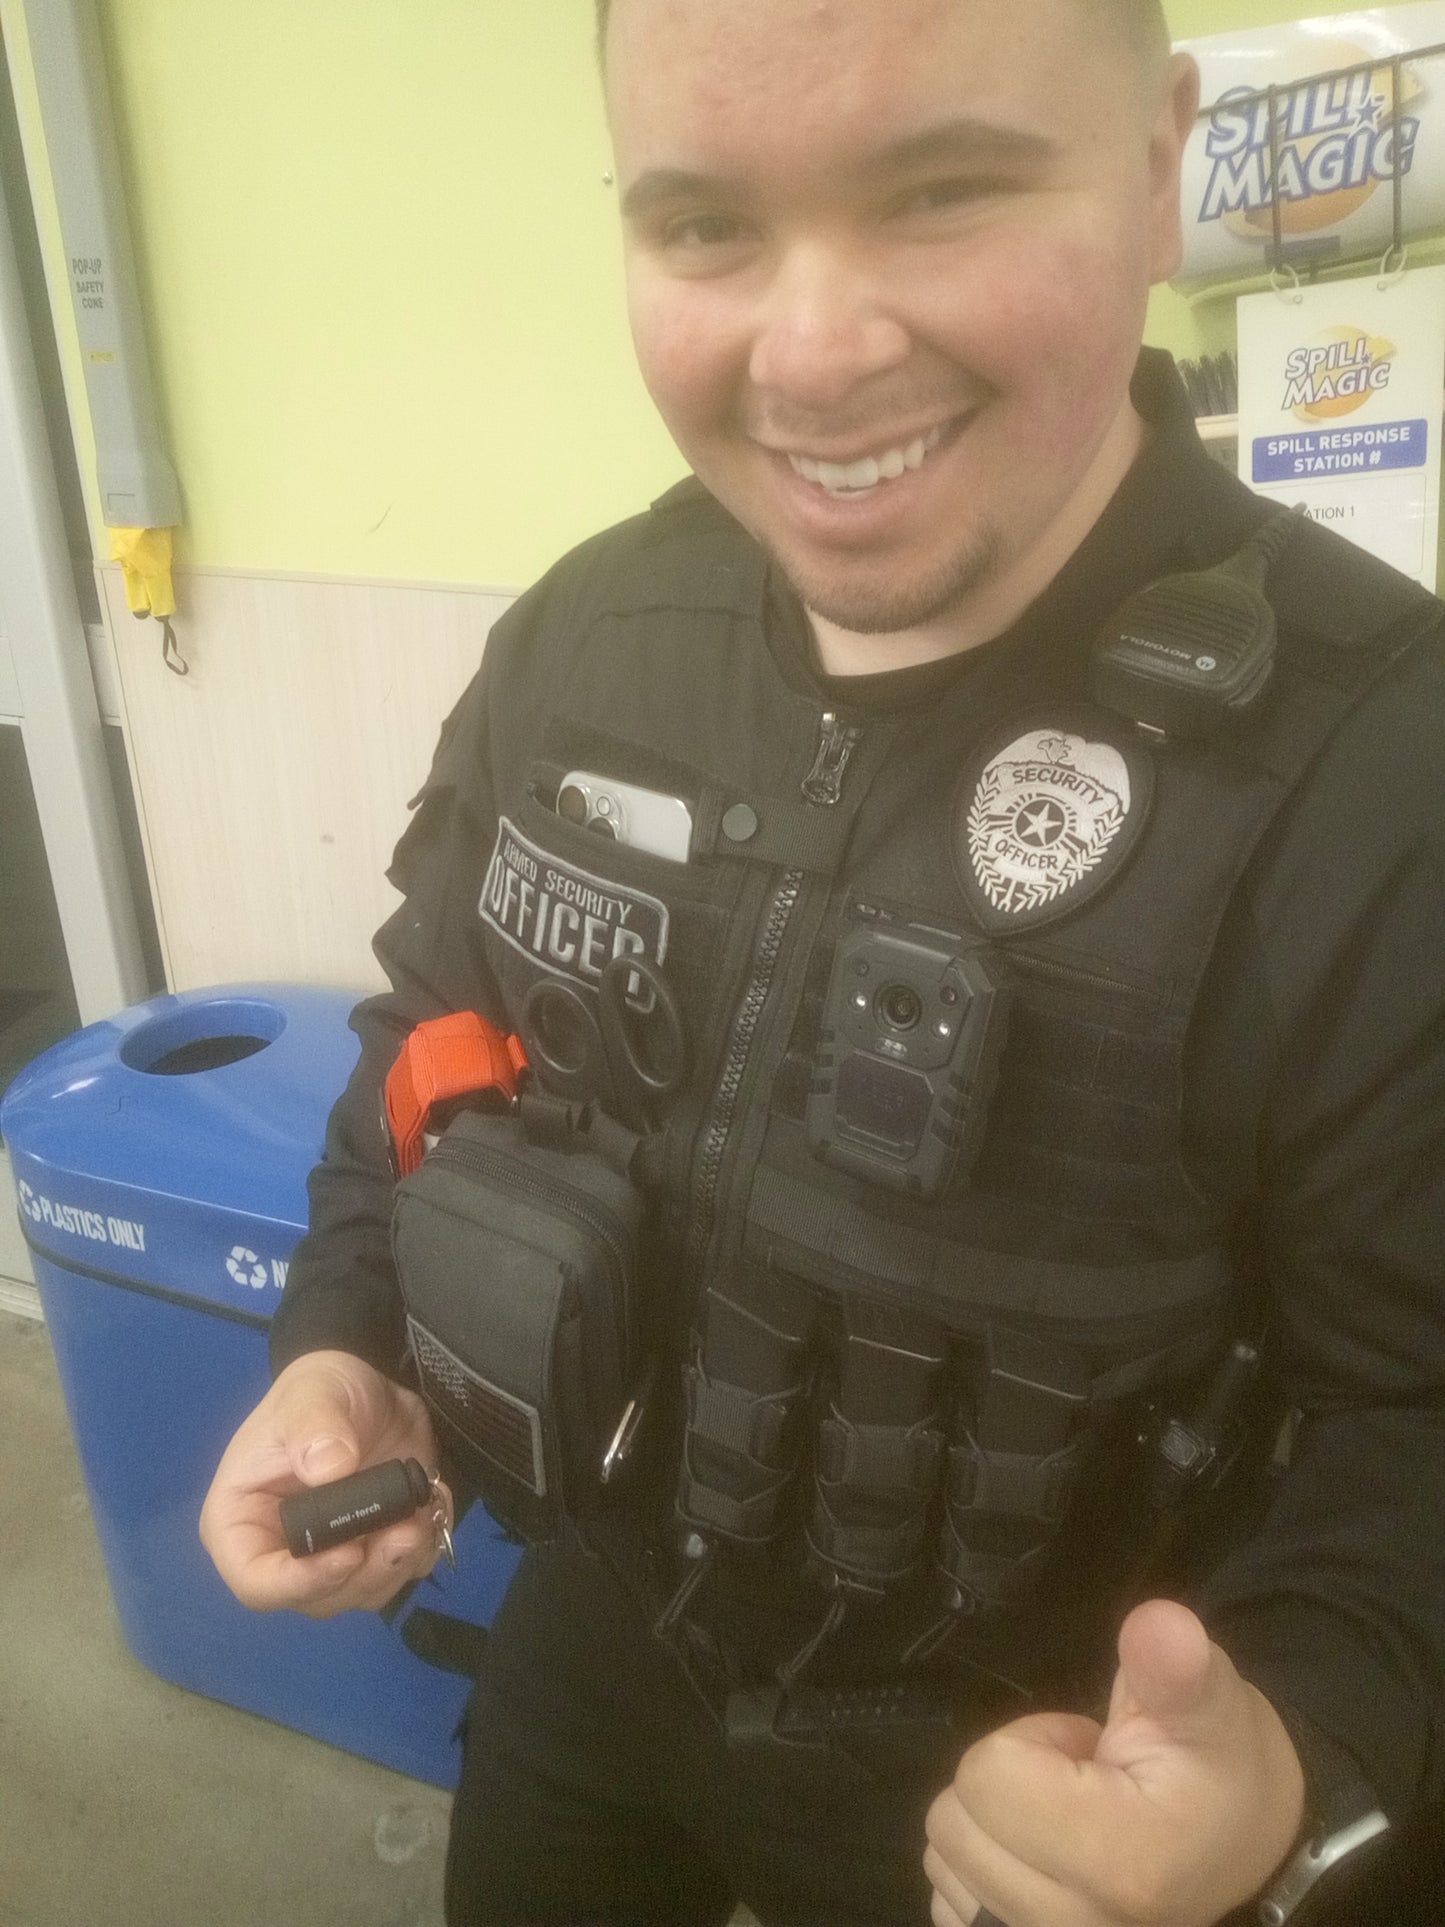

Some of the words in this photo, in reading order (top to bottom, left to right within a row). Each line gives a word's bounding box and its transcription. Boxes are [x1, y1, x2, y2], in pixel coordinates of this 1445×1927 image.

[1205, 69, 1375, 158] SPILL
[1197, 116, 1420, 223] MAGIC
[72, 258, 102, 275] POP-UP
[76, 281, 104, 294] SAFETY
[81, 297, 104, 309] CONE
[1284, 337, 1368, 380] SPILL
[1281, 363, 1391, 411] MAGIC
[1267, 437, 1315, 456] SPILL
[1319, 427, 1410, 451] RESPONSE
[1293, 452, 1364, 474] STATION
[1369, 450, 1381, 464] #
[1305, 506, 1345, 520] ATION
[1120, 634, 1192, 661] MOTOROLA
[1012, 767, 1104, 805] SECURITY
[994, 839, 1058, 870] OFFICER
[503, 838, 538, 883] ARMED
[544, 869, 633, 925] SECURITY
[39, 1194, 107, 1243] PLASTICS
[107, 1215, 146, 1252] ONLY
